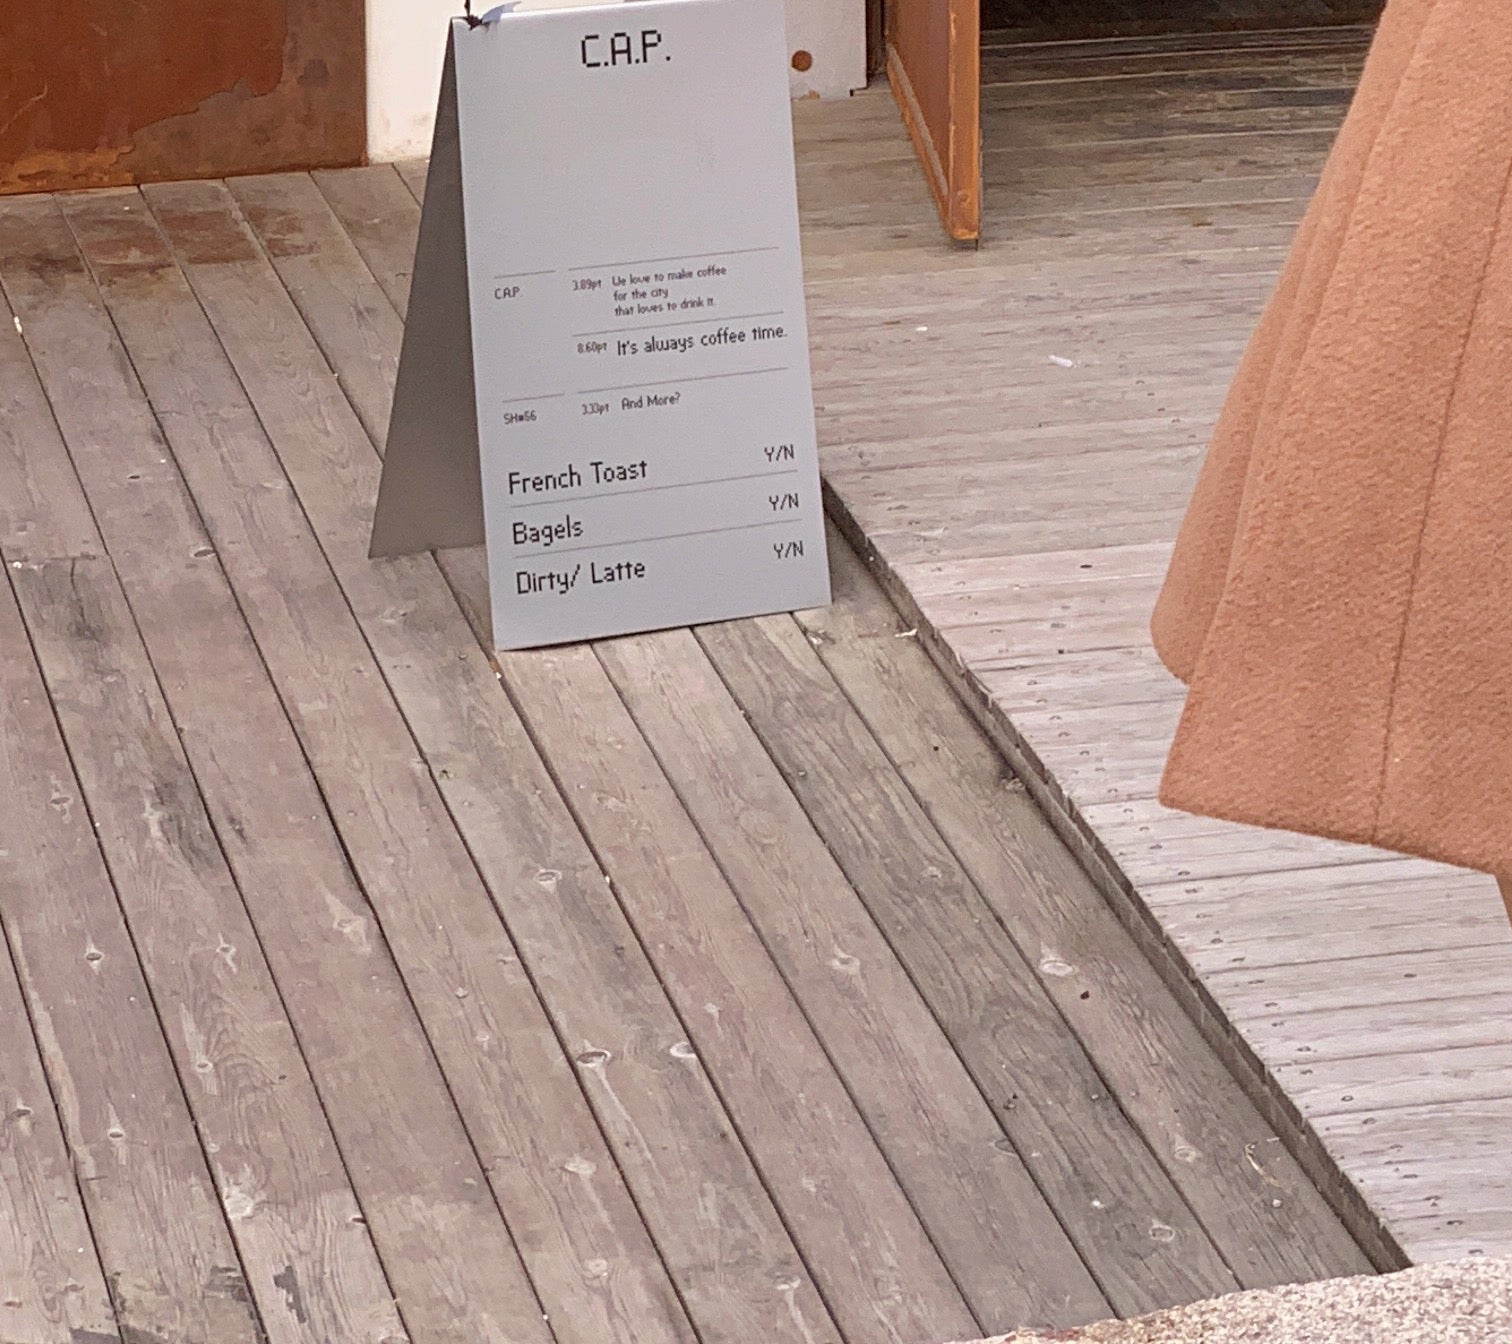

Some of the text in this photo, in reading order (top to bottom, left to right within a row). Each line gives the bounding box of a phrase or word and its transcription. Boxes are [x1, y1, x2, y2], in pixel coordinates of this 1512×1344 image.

[581, 29, 671, 68] C.A.P.
[629, 273, 650, 285] love
[654, 273, 665, 282] to
[667, 268, 693, 281] make
[696, 264, 727, 277] coffee
[613, 287, 669, 302] for the city
[614, 305, 634, 317] that
[637, 303, 664, 315] loves
[667, 301, 678, 311] to
[680, 297, 704, 310] drink
[617, 340, 639, 357] It's
[643, 335, 695, 353] always
[700, 327, 746, 347] coffee
[621, 392, 681, 410] And More?
[763, 443, 795, 463] Y/N
[508, 460, 648, 495] French Toast
[768, 492, 800, 511] Y/N
[512, 515, 584, 547] Bagels
[773, 540, 804, 559] Y/N
[590, 561, 646, 585] Latte
